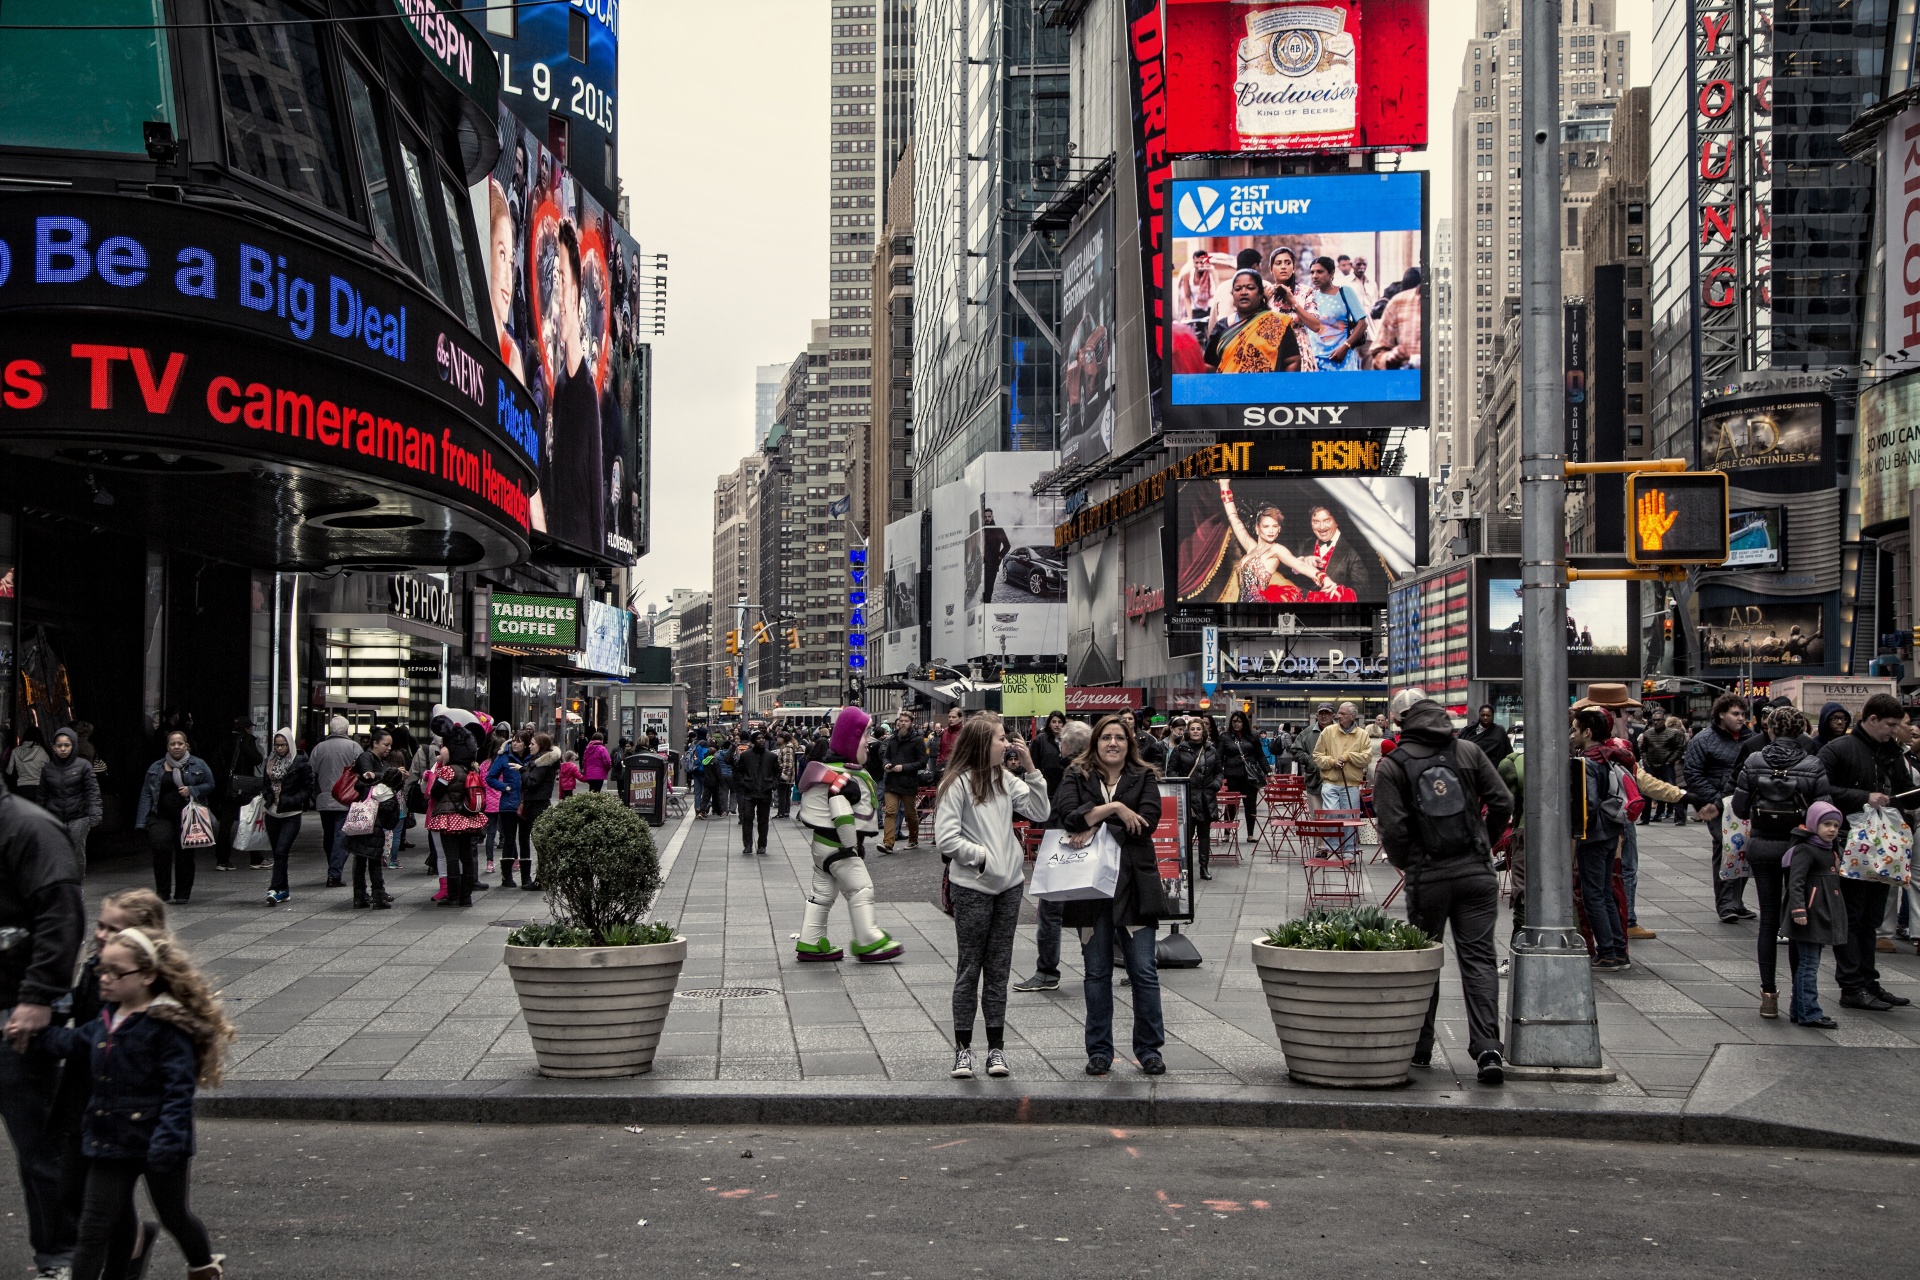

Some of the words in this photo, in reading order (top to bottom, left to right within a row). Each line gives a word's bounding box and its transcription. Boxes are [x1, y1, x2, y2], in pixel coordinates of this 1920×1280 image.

[571, 75, 613, 134] 2015
[1235, 81, 1358, 107] Budweiser
[1699, 13, 1735, 307] YOUNG
[1230, 185, 1269, 200] 21ST
[1230, 199, 1311, 217] CENTURY
[1230, 216, 1264, 231] FOX
[35, 216, 149, 288] Be
[175, 246, 216, 299] a
[239, 243, 316, 341] Big
[329, 274, 408, 362] Deal
[1571, 310, 1579, 366] TIMES
[450, 341, 484, 407] NEWS
[71, 344, 185, 415] TV
[207, 375, 436, 474] cameraman
[442, 428, 479, 494] from
[497, 378, 524, 447] Police
[1243, 405, 1349, 427] SONY
[1165, 436, 1214, 445] SHERWOOD
[1571, 407, 1579, 463] SQUAR
[1715, 419, 1780, 462] A.D.
[1867, 437, 1876, 453] SO
[1877, 431, 1895, 449] YOU
[1312, 440, 1380, 471] RISING
[1739, 453, 1805, 466] CONTINUES
[1875, 455, 1891, 473] YOU
[394, 574, 455, 628] SEPHORA
[492, 602, 575, 621] TARBUCKS
[498, 620, 556, 637] COFFEE
[1206, 628, 1215, 682] NYPD
[1220, 649, 1264, 673] NEW
[1269, 649, 1321, 674] YORK
[1329, 649, 1387, 674] POLIC
[1710, 657, 1730, 665] EASTER
[1731, 656, 1761, 665] SUNDAY
[1002, 674, 1027, 684] JESUS
[1003, 684, 1028, 694] LOVES
[1035, 684, 1052, 694] YOU
[1851, 685, 1869, 694] TEA
[1065, 691, 1132, 708] algreens
[631, 770, 657, 784] JERSEY
[1049, 852, 1089, 862] ALDO
